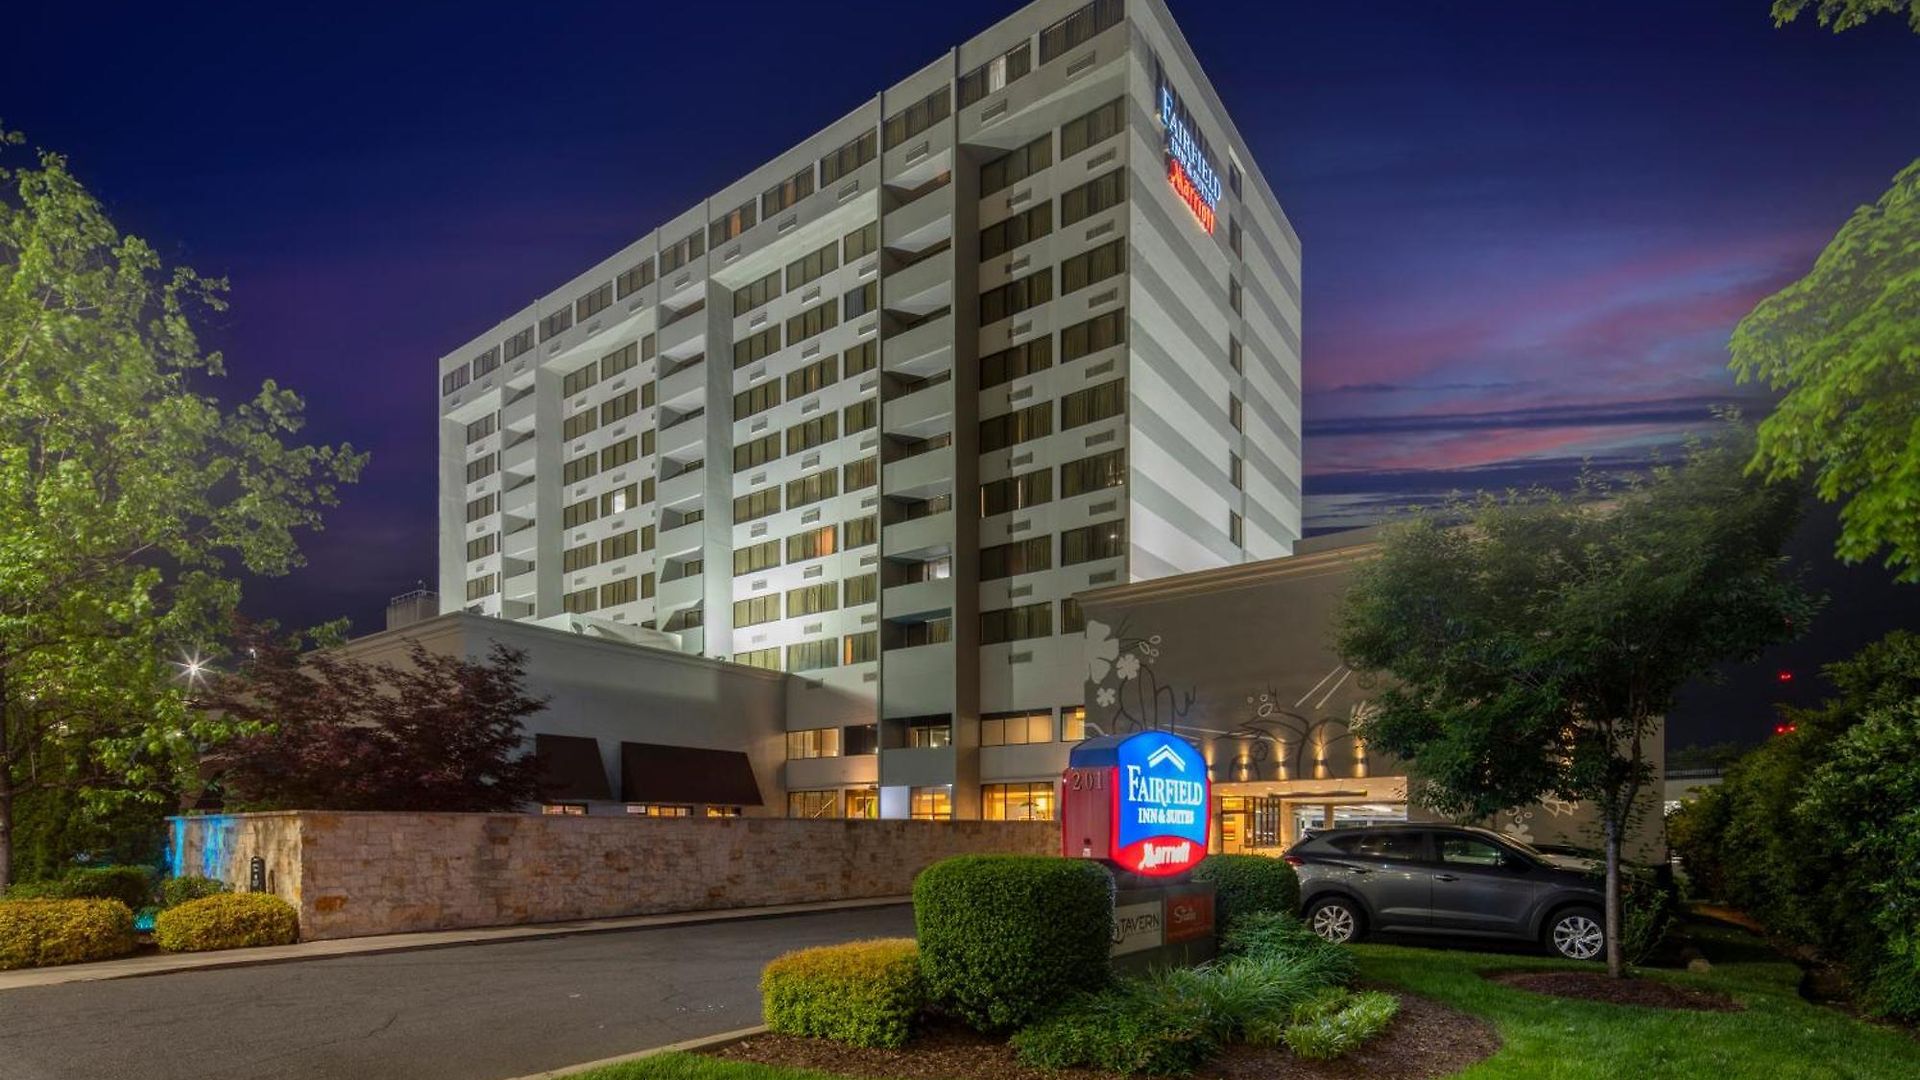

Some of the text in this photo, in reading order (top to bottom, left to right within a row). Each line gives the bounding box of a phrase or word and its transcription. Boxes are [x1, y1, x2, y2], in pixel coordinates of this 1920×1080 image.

[1162, 86, 1222, 201] FAIRFIELD
[1167, 158, 1215, 237] Marriott
[1072, 771, 1104, 791] 201
[1127, 765, 1203, 806] FAIRFIELD
[1137, 842, 1191, 870] Marriott
